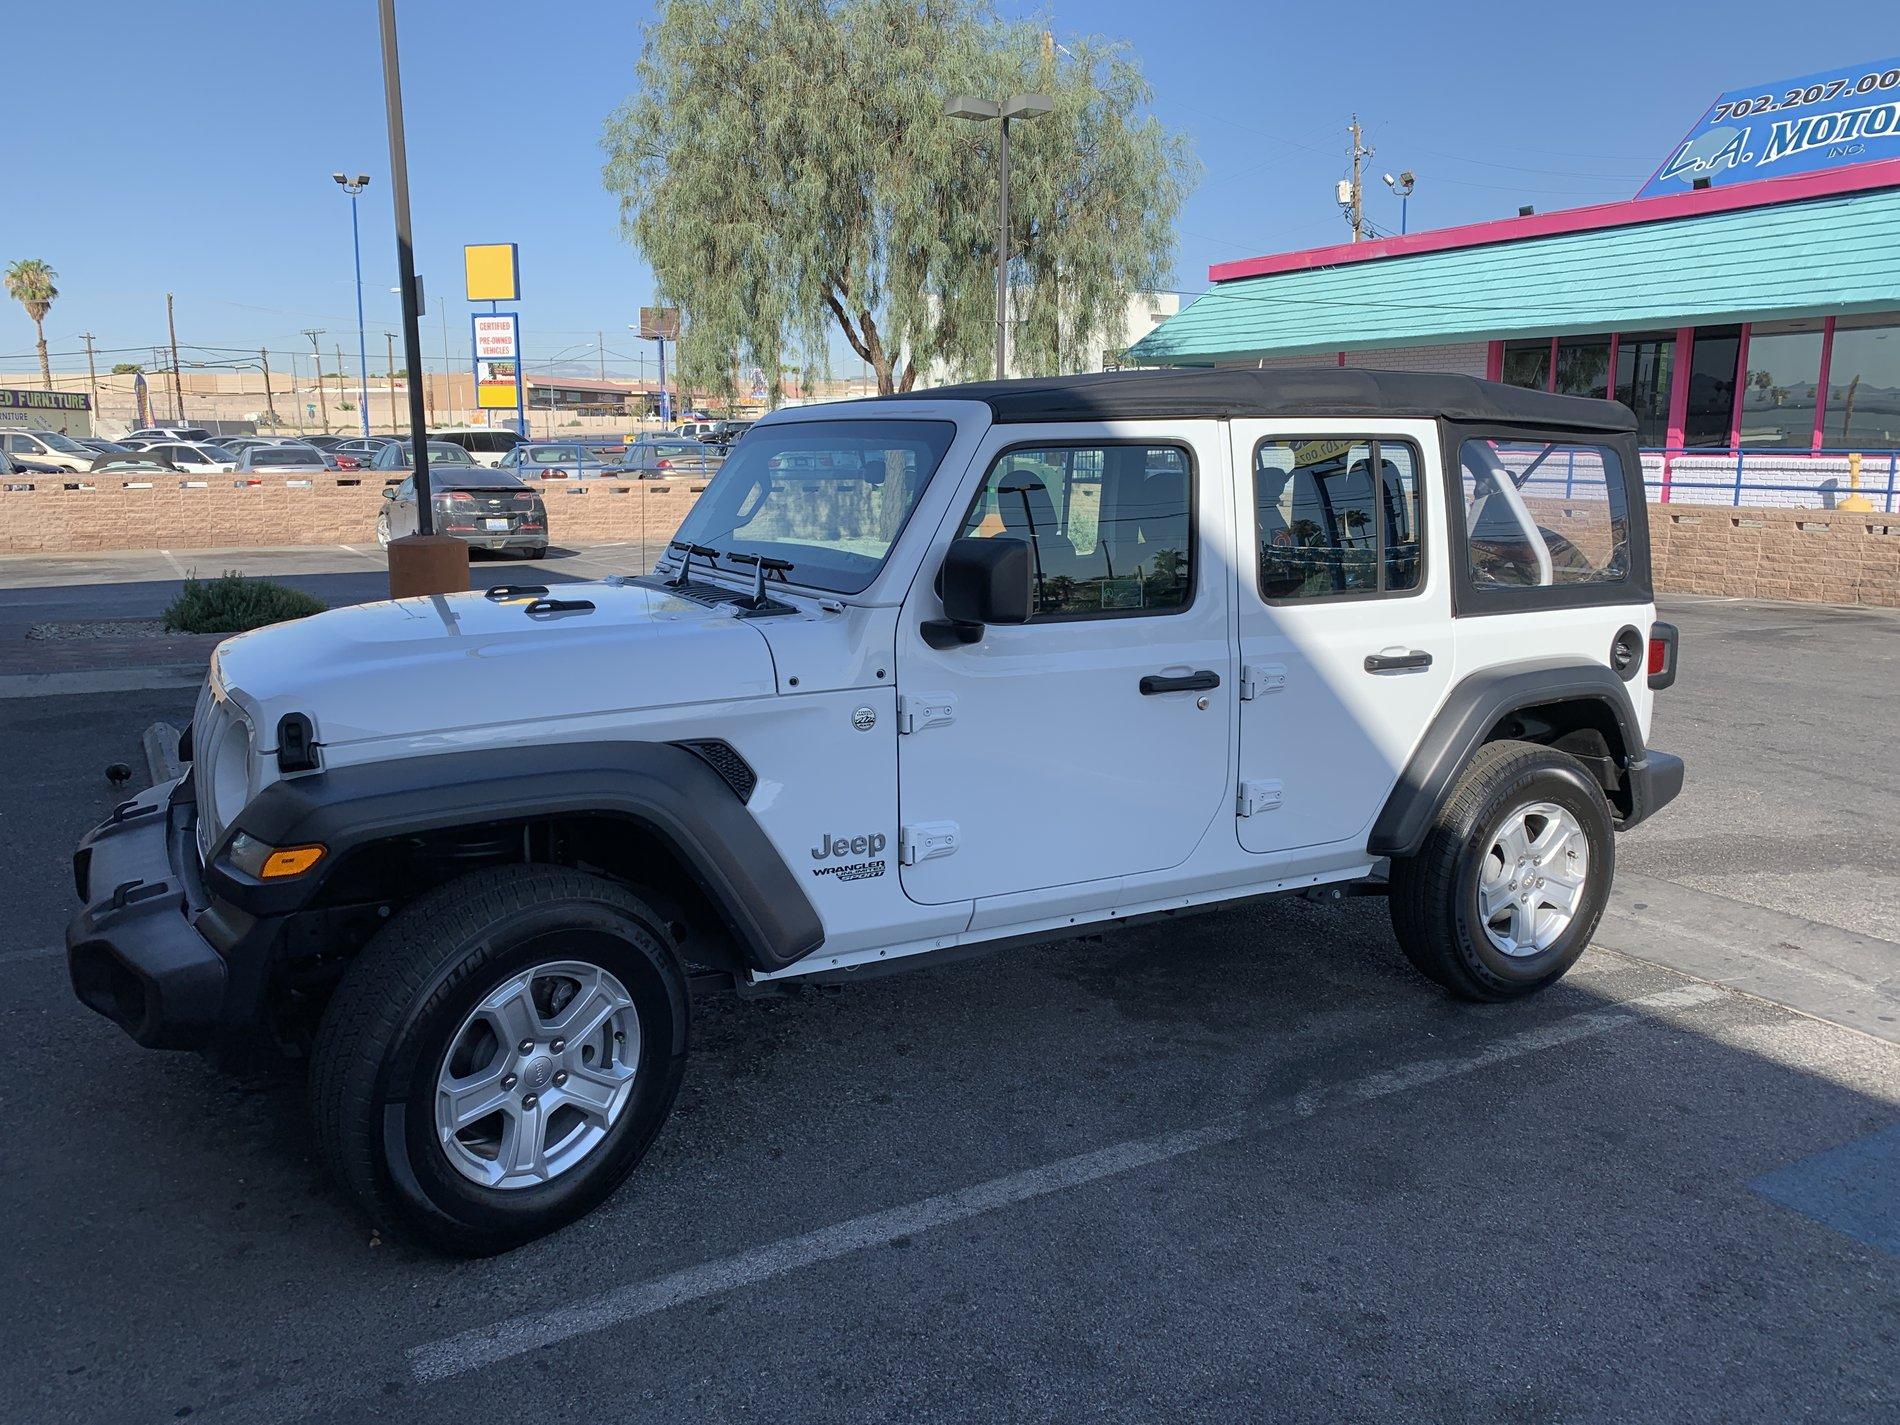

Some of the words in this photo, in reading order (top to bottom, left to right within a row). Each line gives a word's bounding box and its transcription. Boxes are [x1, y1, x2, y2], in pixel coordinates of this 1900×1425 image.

[1711, 68, 1900, 123] 702.207.00
[1660, 127, 1753, 180] L.A.
[1756, 101, 1900, 167] MOTO
[479, 322, 511, 331] CERTIFIED
[479, 336, 512, 345] PRE-OWNED
[482, 346, 510, 355] VEHICLES
[18, 391, 86, 409] FURNITURE
[811, 832, 886, 859] Jeep
[812, 860, 886, 876] WRANGLER
[840, 871, 884, 880] SPORT
